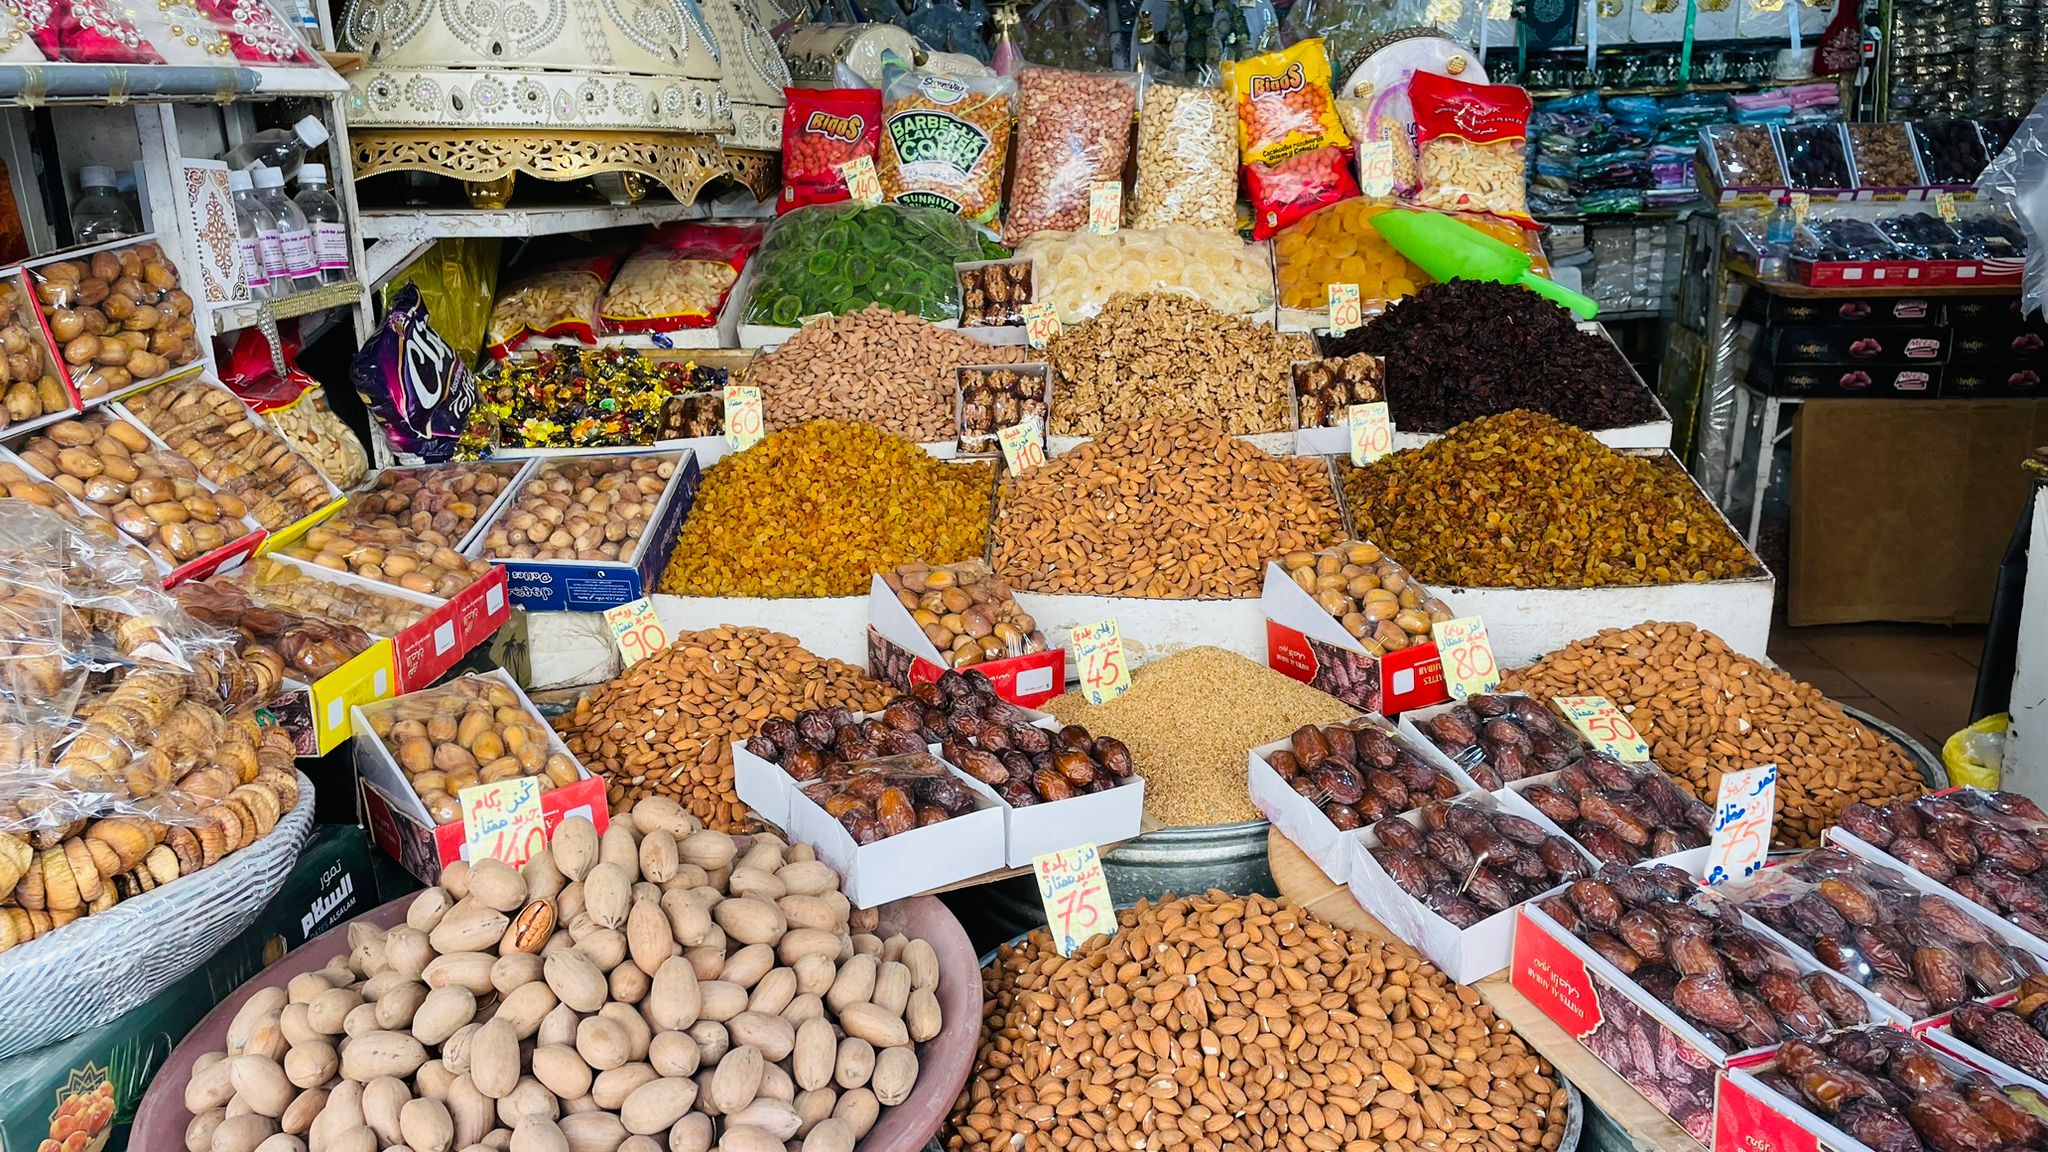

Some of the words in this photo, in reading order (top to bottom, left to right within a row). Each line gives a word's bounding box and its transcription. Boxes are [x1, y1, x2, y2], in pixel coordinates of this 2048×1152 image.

[902, 194, 956, 212] SUNNIVA
[1092, 205, 1120, 228] 140
[1028, 318, 1060, 340] 120
[1335, 304, 1359, 326] 60
[731, 408, 761, 435] 60
[1358, 426, 1389, 457] 40
[1012, 442, 1043, 474] 110
[512, 571, 553, 583] Dattes
[622, 624, 666, 659] 90
[1087, 650, 1120, 689] 45
[1451, 643, 1495, 681] 80
[1589, 717, 1636, 742] 50
[1749, 766, 1777, 797] تمر
[1715, 803, 1746, 832] ممتاز
[1721, 818, 1767, 866] 75
[320, 858, 343, 892] تمور
[300, 872, 354, 940] السلام
[328, 895, 357, 925] ALSALAM
[1056, 885, 1102, 938] 75
